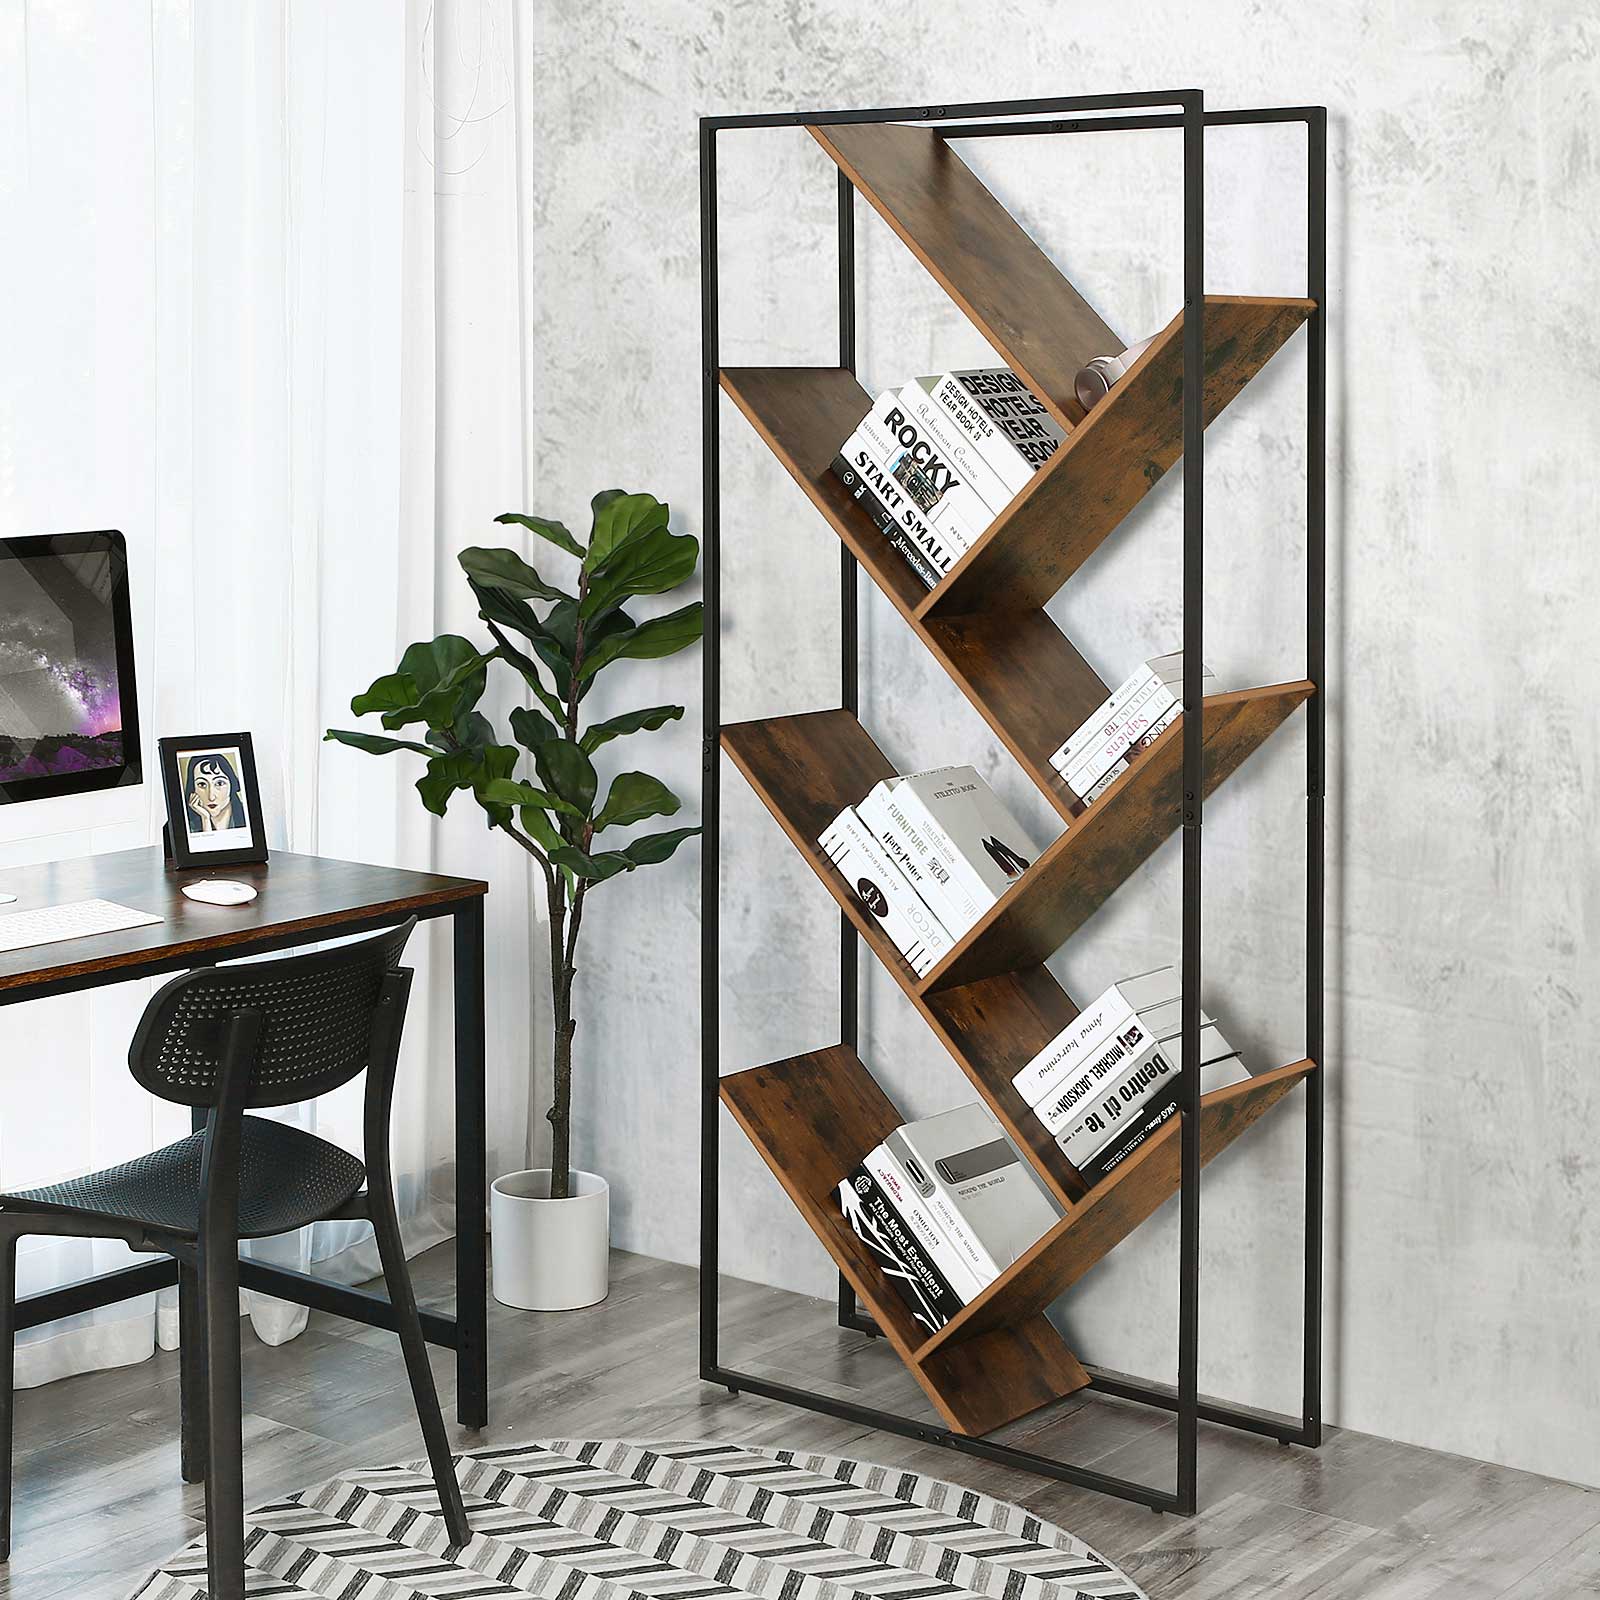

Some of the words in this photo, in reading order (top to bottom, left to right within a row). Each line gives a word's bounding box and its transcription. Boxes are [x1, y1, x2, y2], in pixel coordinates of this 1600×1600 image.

[958, 373, 1028, 395] DESIGN
[939, 390, 957, 413] YEAR
[956, 410, 975, 434] BOOK
[945, 380, 969, 409] DESIGN
[967, 406, 993, 437] HOTELS
[977, 394, 1048, 418] HOTELS
[994, 417, 1050, 440] YEAR
[884, 407, 960, 494] ROCKY
[854, 451, 904, 508] START
[901, 509, 952, 574] SMALL
[1104, 722, 1119, 736] TED
[1106, 714, 1149, 757] Sapiens
[1141, 720, 1168, 748] KING
[887, 803, 928, 855] FURNITURE
[907, 904, 941, 948] DECOR
[1080, 1012, 1103, 1039] Anna
[1089, 1044, 1125, 1080] MICHAEL
[1118, 1052, 1170, 1102] Dentro
[1058, 1074, 1093, 1113] JACKSON
[1102, 1095, 1122, 1121] di
[1085, 1112, 1106, 1133] te
[873, 1196, 889, 1219] The
[888, 1218, 909, 1247] Most
[907, 1246, 944, 1296] Excellent
